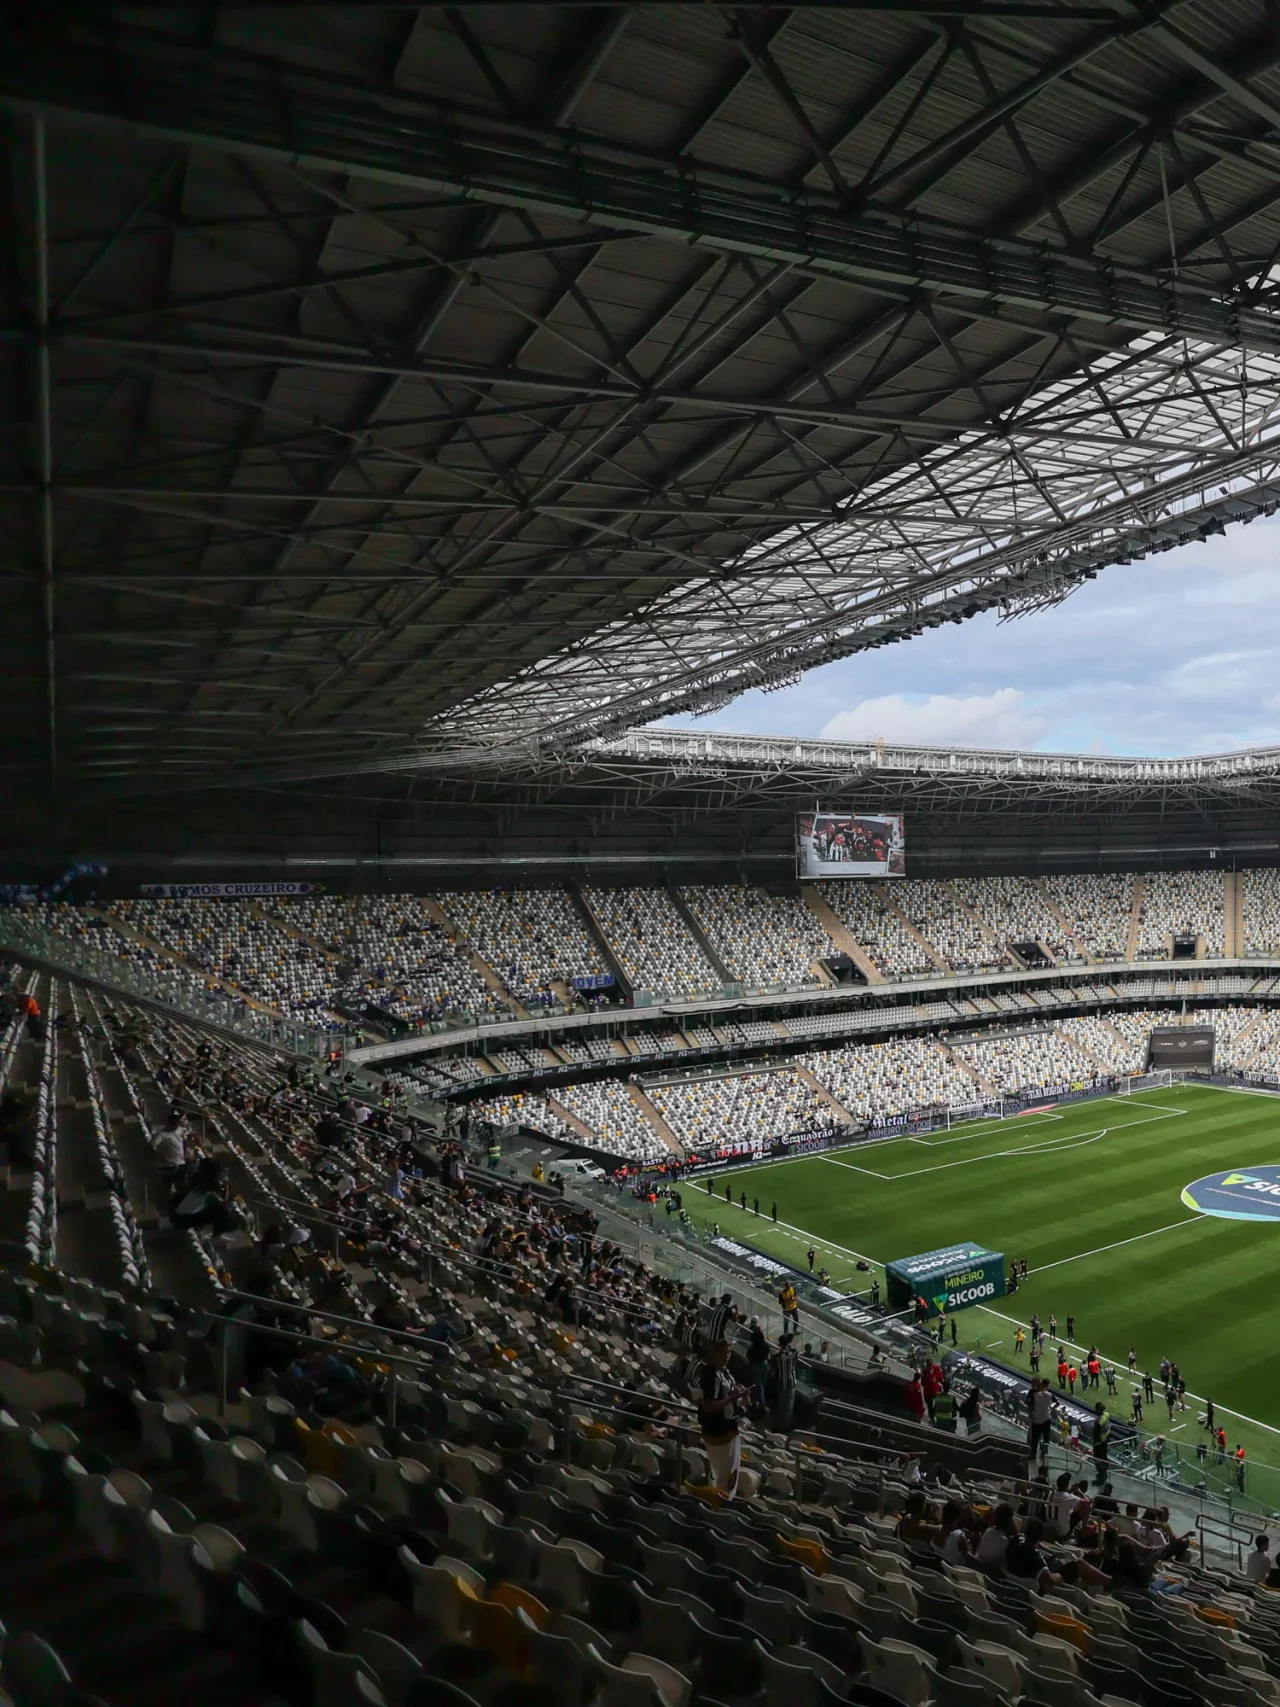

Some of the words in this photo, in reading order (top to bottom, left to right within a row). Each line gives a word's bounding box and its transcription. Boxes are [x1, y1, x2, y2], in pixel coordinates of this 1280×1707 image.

[224, 883, 296, 894] CRUZEIRO
[781, 1128, 833, 1145] Esquadrão
[868, 1126, 900, 1139] MINEIRO
[796, 1140, 825, 1153] SICOOB
[944, 1269, 985, 1290] MINEIRO
[948, 1282, 995, 1307] SICOOB
[831, 1305, 874, 1324] GALO
